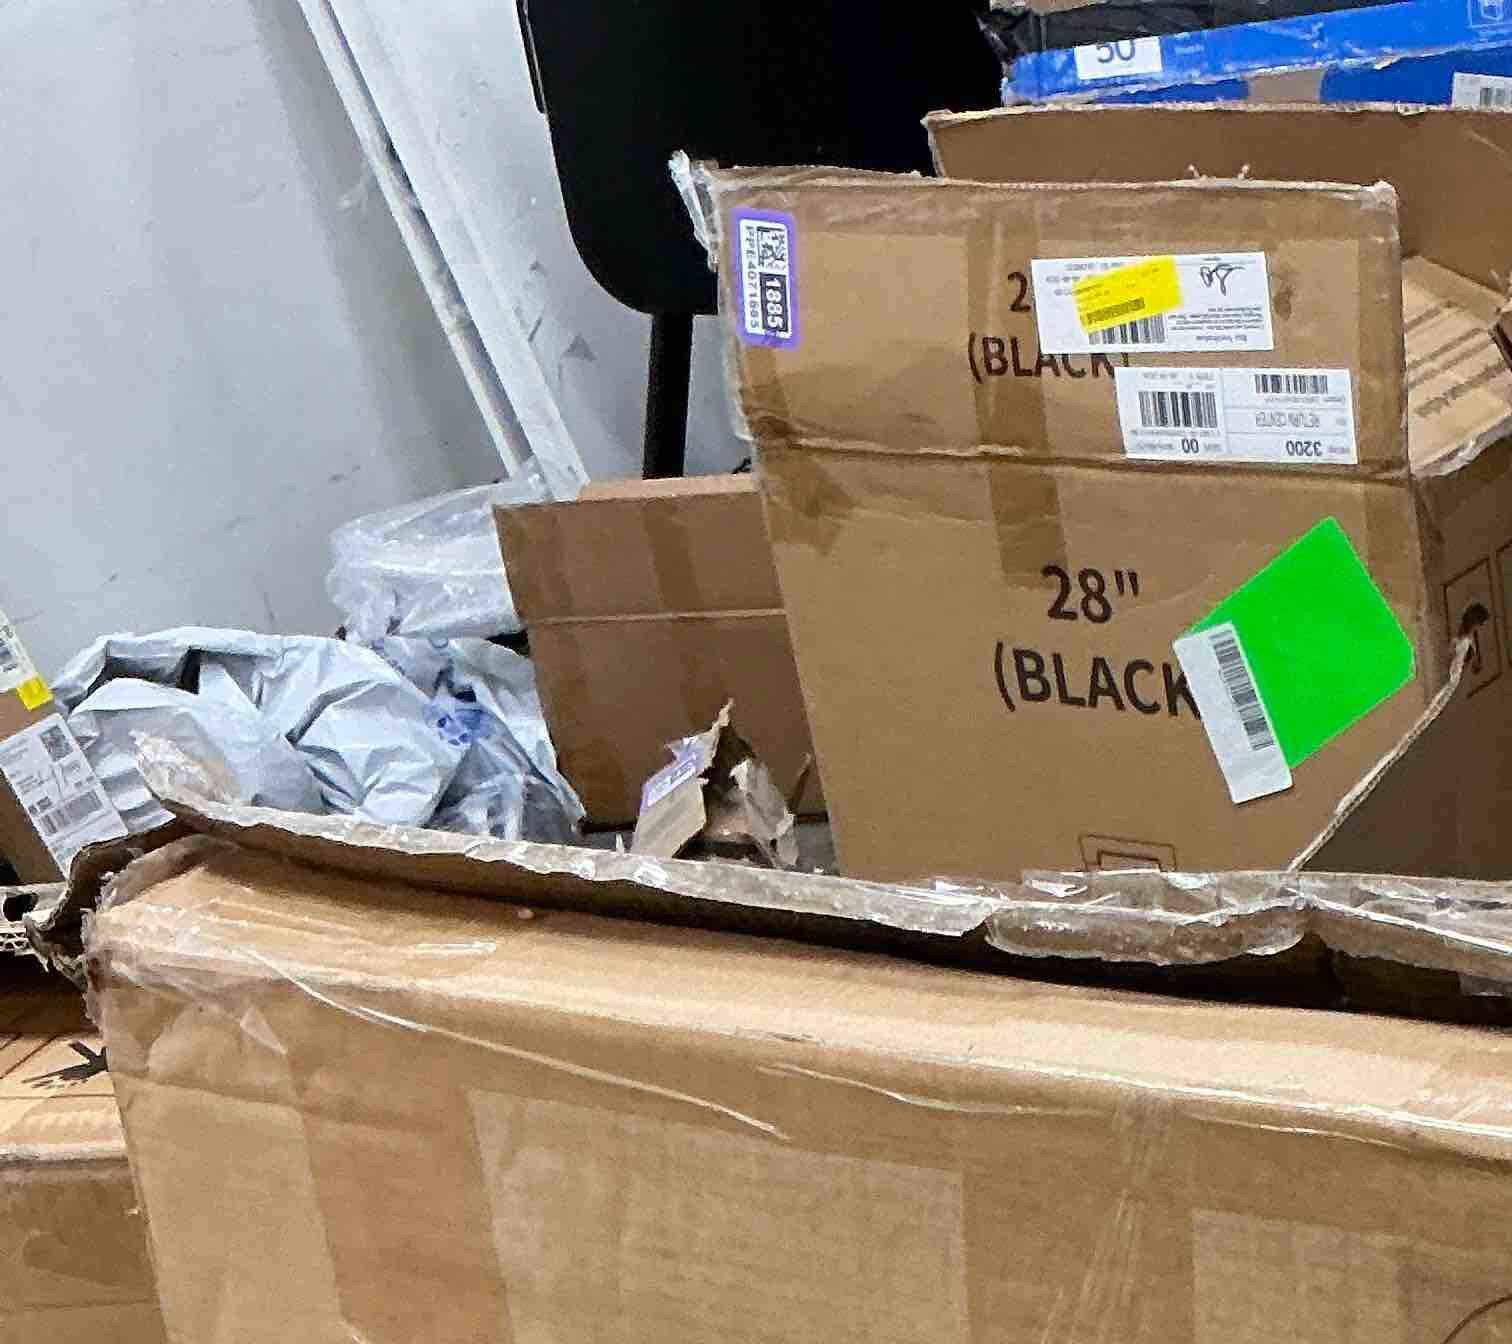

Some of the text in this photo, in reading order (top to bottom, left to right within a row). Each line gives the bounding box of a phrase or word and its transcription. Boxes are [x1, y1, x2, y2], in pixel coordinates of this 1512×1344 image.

[765, 278, 784, 328] 1885
[1286, 440, 1323, 457] 3200
[1041, 564, 1139, 624] 28"
